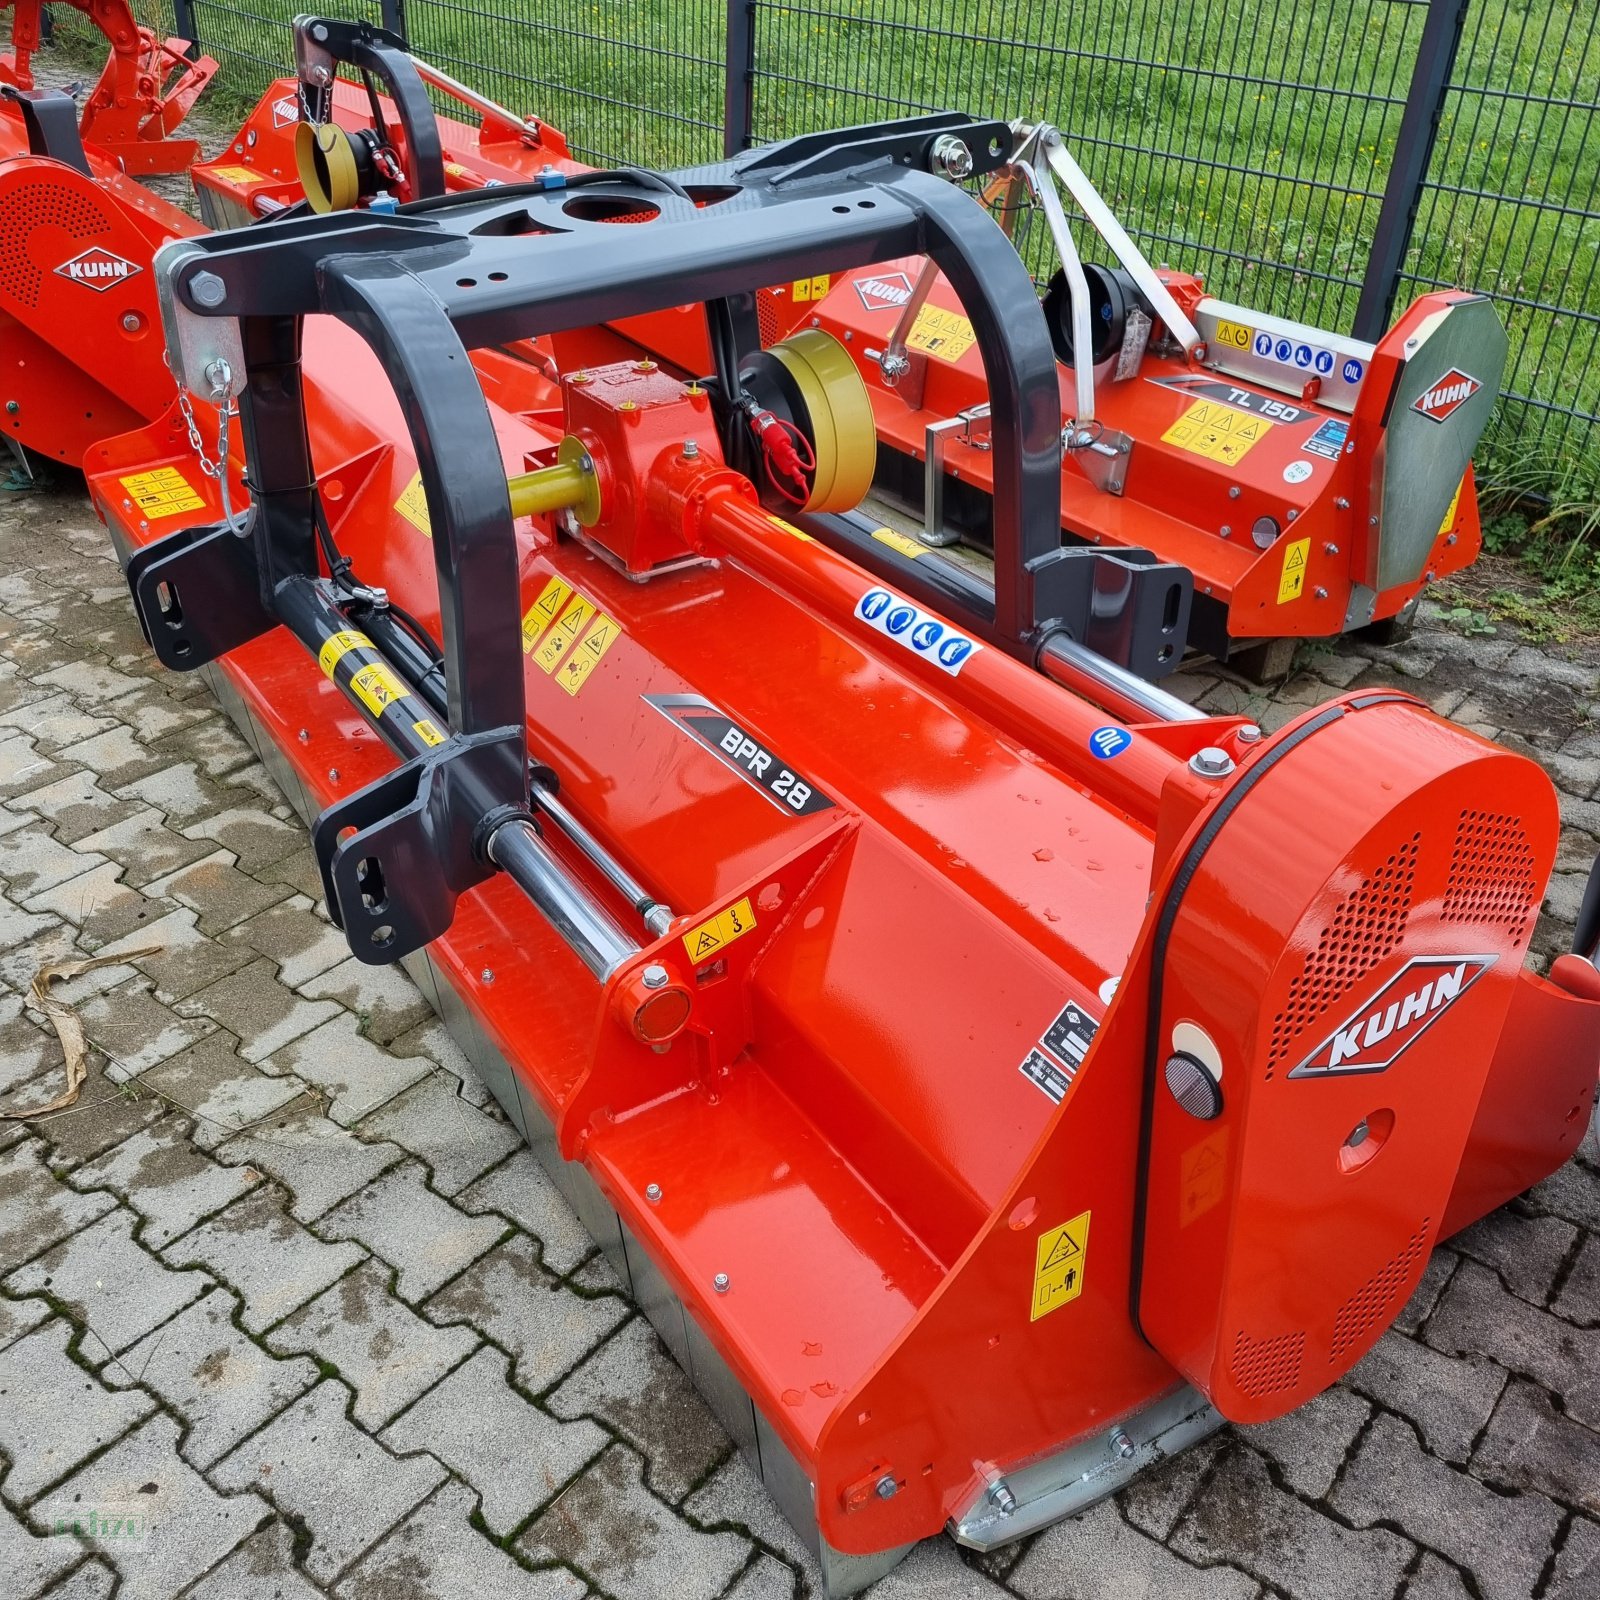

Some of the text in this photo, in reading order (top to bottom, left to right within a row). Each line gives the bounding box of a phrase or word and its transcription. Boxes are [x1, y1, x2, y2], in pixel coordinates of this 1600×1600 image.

[69, 262, 129, 278] KUHN
[861, 280, 911, 304] KUHN
[1344, 363, 1359, 381] OIL
[1227, 387, 1300, 422] TL 150
[1422, 380, 1473, 411] KUHN
[1292, 463, 1308, 477] TEST
[1094, 728, 1124, 756] OIL
[719, 726, 812, 810] BPR 28
[1328, 962, 1467, 1069] KUHN
